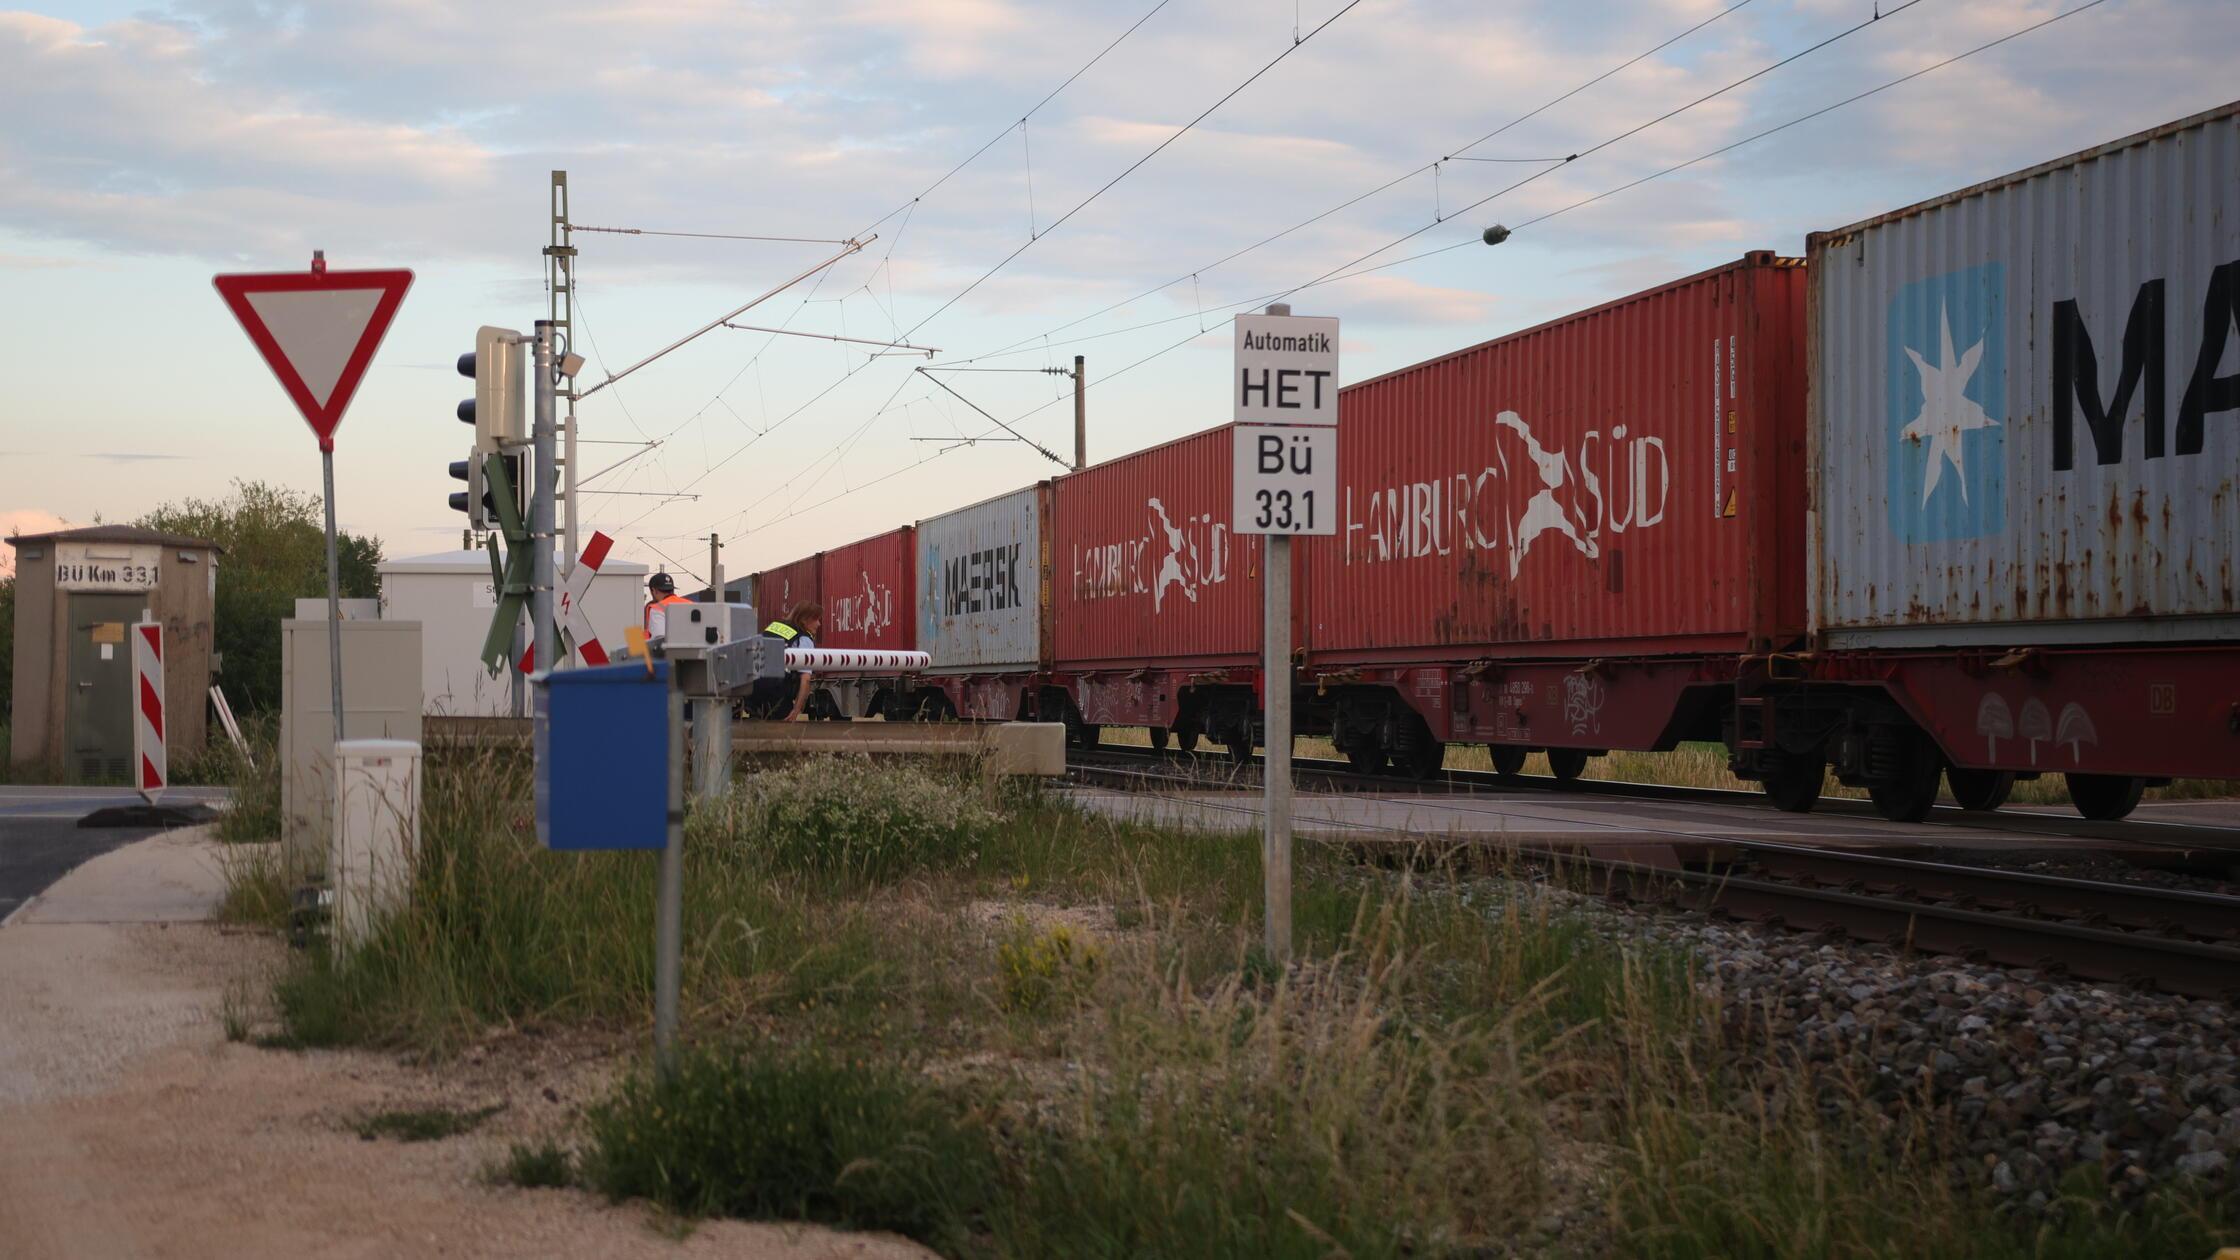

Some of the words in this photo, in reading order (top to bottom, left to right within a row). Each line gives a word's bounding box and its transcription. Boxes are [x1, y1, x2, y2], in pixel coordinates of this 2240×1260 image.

[1243, 330, 1331, 353] Automatik
[1242, 368, 1331, 409] HET
[1258, 435, 1312, 475] Bü
[1580, 424, 1668, 538] SÜD
[1256, 489, 1314, 532] 33,1
[89, 565, 116, 582] Km
[122, 566, 159, 585] 33,1
[945, 542, 1021, 617] MAERSK
